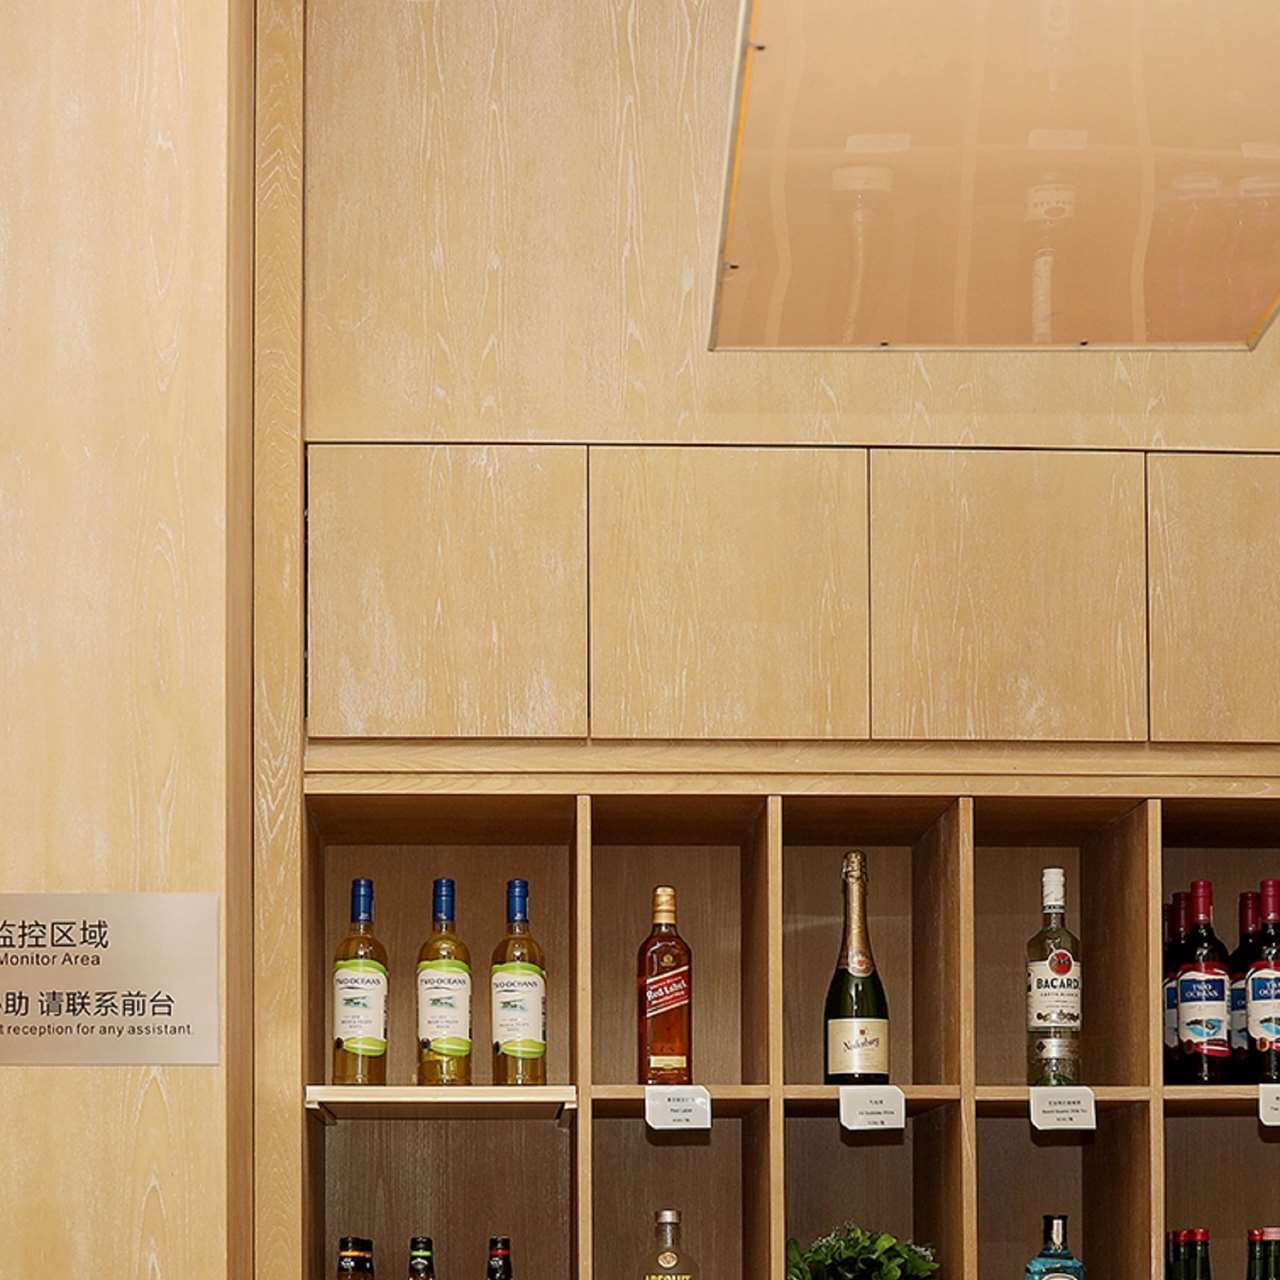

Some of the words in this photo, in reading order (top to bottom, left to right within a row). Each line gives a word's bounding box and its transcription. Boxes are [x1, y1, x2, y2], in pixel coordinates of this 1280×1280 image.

[61, 953, 101, 967] Area
[1036, 977, 1080, 990] BACARD
[38, 990, 176, 1018] 请联系前台
[7, 1023, 74, 1039] reception
[76, 1023, 96, 1036] for
[99, 1026, 125, 1039] any
[127, 1023, 192, 1036] assistant
